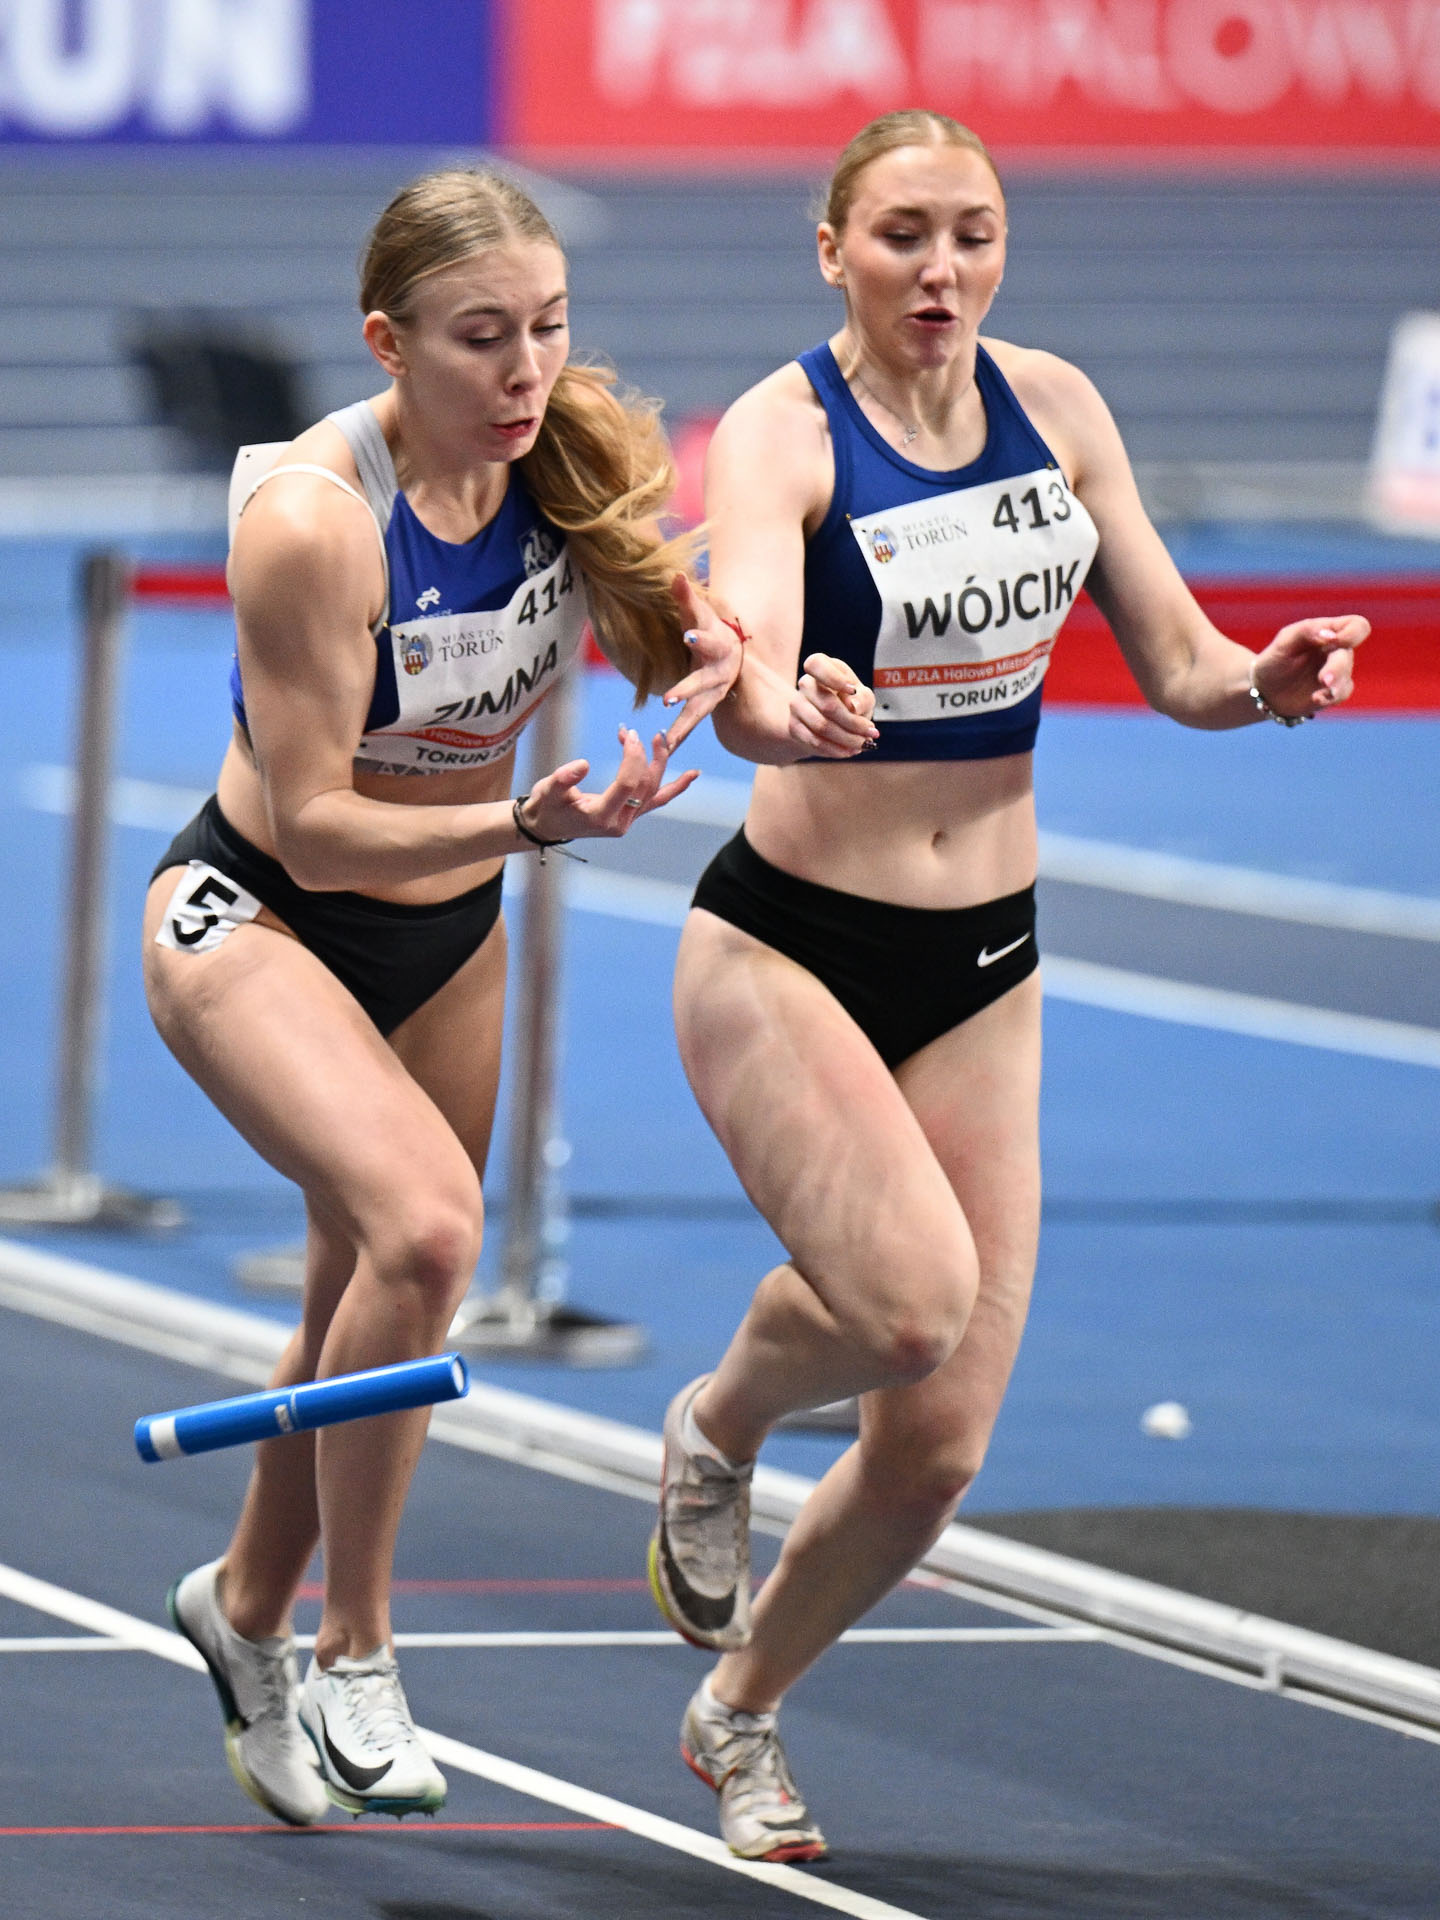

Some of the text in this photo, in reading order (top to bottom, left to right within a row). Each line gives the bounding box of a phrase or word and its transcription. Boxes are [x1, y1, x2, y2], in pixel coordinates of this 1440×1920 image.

[992, 481, 1072, 534] 413
[517, 558, 574, 626] 414
[903, 560, 1080, 640] WÓJCIK
[441, 628, 496, 645] MIASTO
[423, 640, 558, 727] ZIMNA
[884, 670, 905, 684] 70.
[908, 668, 940, 683] PZLA
[944, 664, 994, 681] Halowe
[937, 680, 1007, 709] TORUŃ
[172, 876, 239, 946] 5
